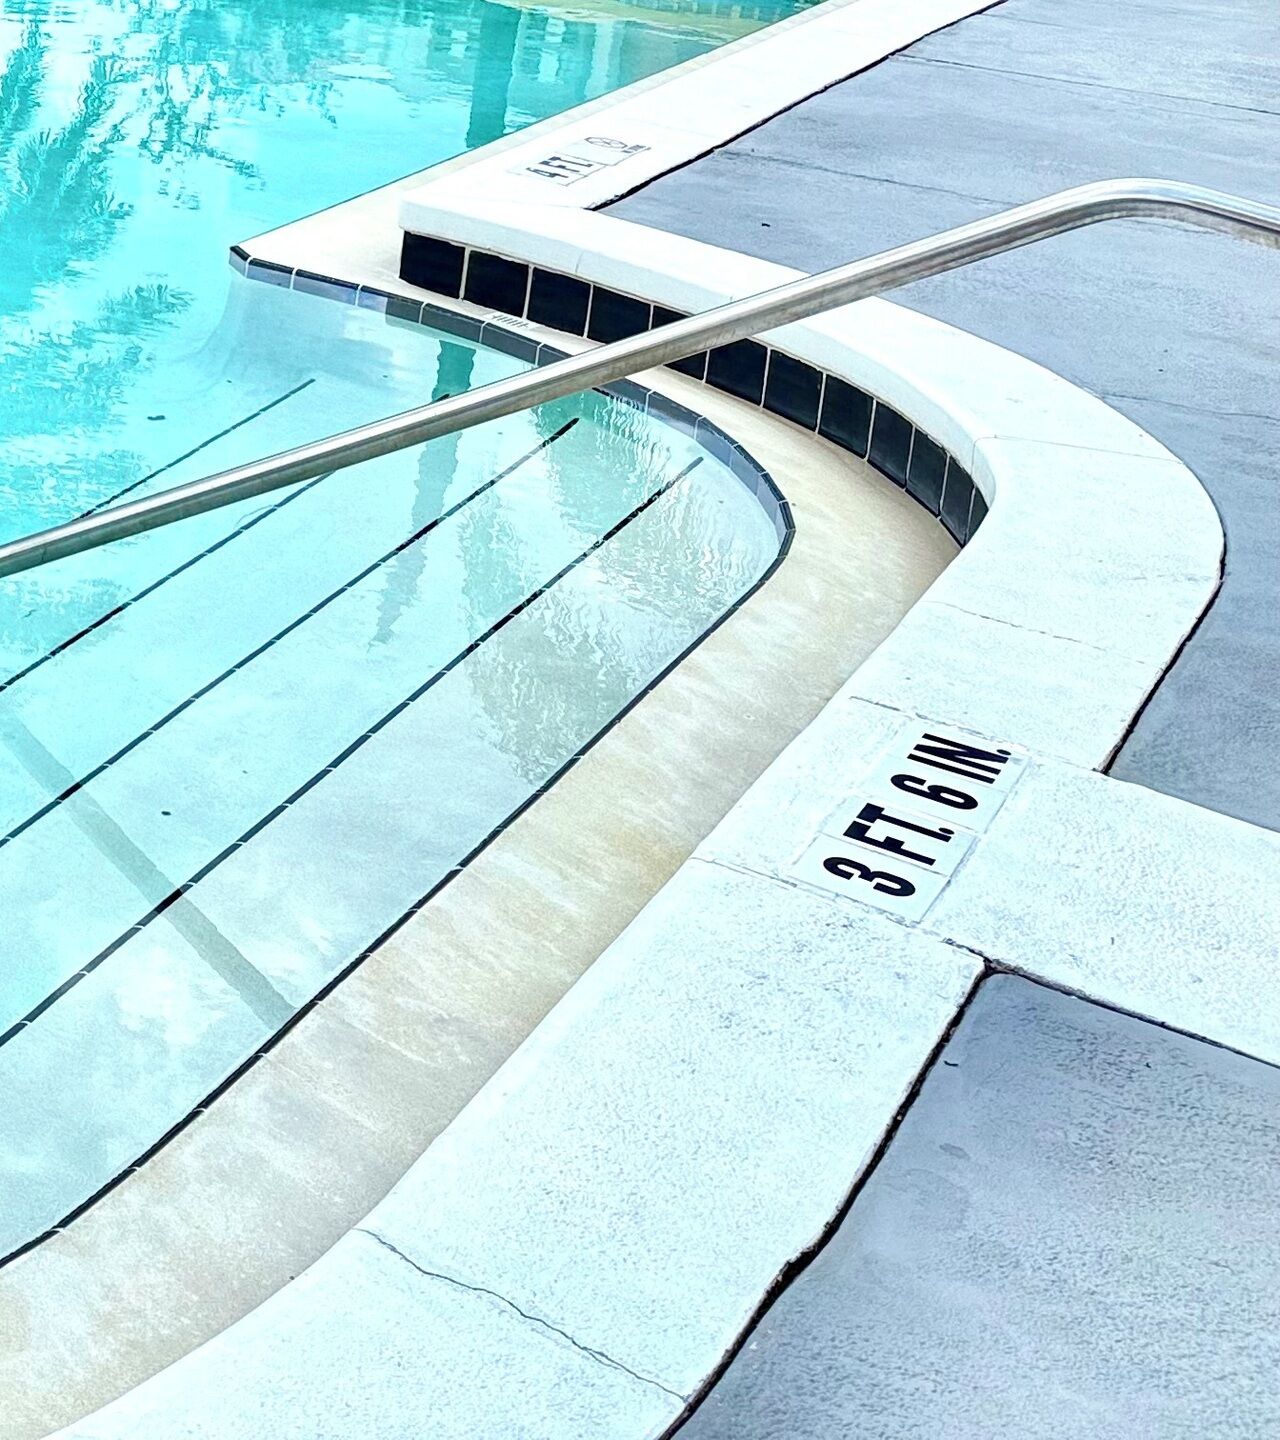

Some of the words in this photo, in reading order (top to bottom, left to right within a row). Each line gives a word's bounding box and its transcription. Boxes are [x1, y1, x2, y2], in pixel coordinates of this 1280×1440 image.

[525, 167, 570, 178] 4
[906, 733, 1012, 785] IN.
[890, 774, 979, 810] 6
[842, 802, 955, 866] FT.
[823, 856, 916, 897] 3
